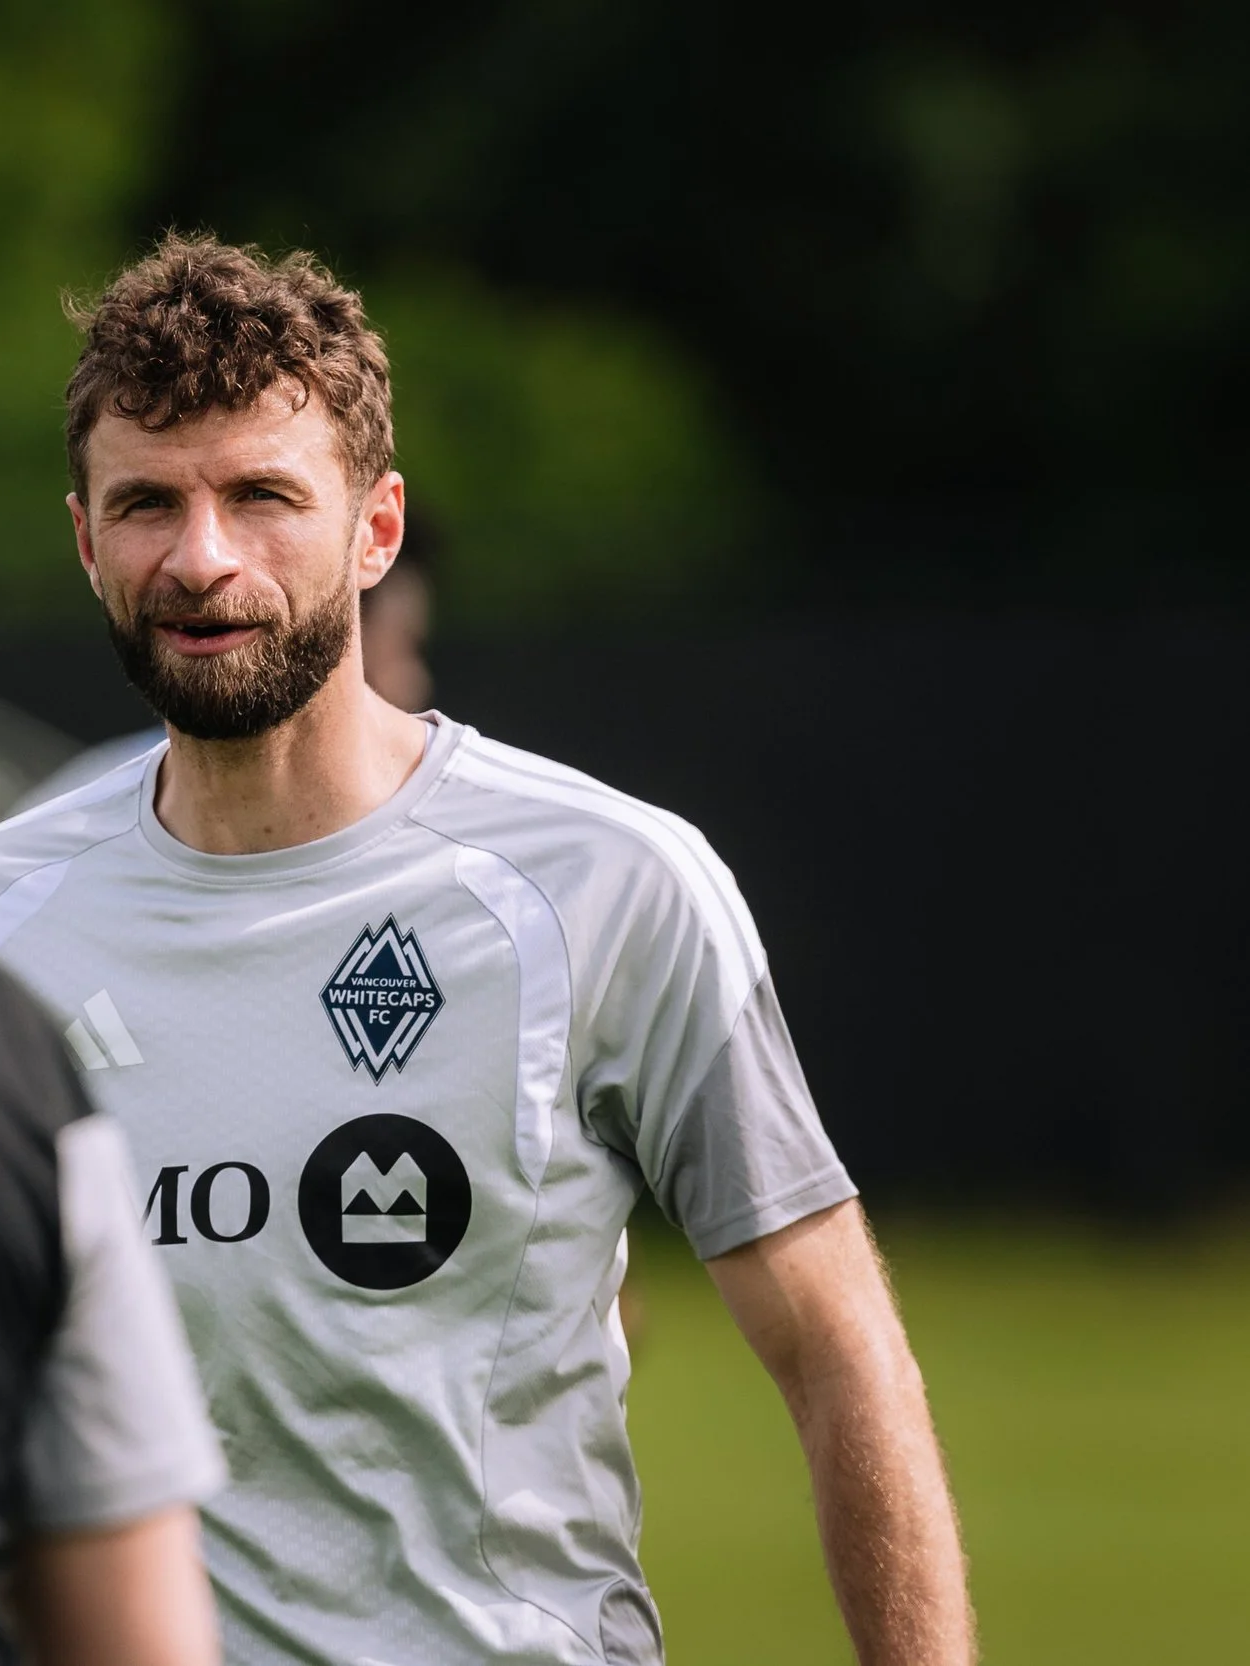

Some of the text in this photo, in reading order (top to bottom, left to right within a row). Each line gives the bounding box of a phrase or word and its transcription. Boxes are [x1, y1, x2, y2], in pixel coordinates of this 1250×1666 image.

[351, 977, 417, 988] VANCOUVER
[329, 988, 435, 1008] WHITECAPS
[368, 1009, 391, 1025] FC
